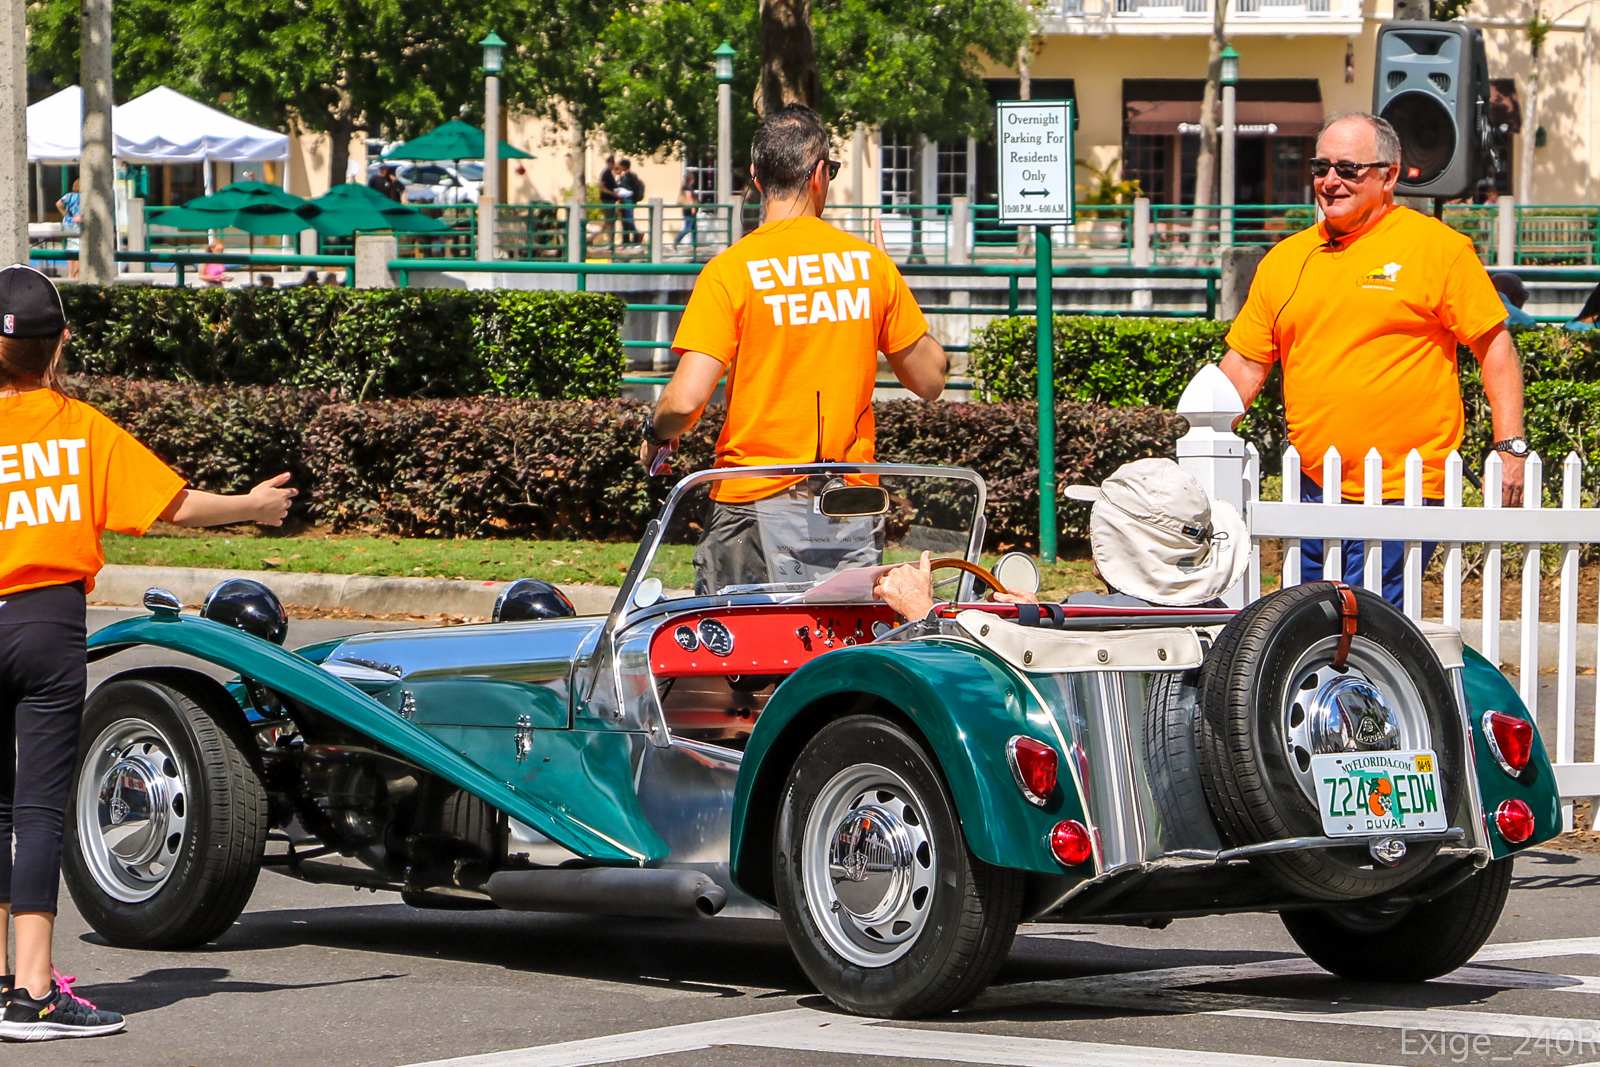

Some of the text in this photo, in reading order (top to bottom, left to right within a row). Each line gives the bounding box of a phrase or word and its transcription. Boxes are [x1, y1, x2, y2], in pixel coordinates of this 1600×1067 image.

[1008, 113, 1059, 126] Overnight
[1003, 131, 1065, 145] Parking For
[1010, 151, 1058, 163] Residents
[1022, 169, 1047, 183] Only
[1004, 204, 1020, 213] 10:00
[1020, 204, 1033, 213] P.M.
[1039, 204, 1052, 213] 6:00
[1052, 204, 1066, 213] A.M.
[746, 250, 872, 290] EVENT
[763, 287, 870, 326] TEAM
[0, 484, 81, 531] AM
[1359, 731, 1382, 743] LOTUS
[1341, 756, 1411, 774] MYFLORIDA.COM
[1323, 773, 1438, 817] Z24 EDW
[1366, 818, 1406, 830] DUVAL
